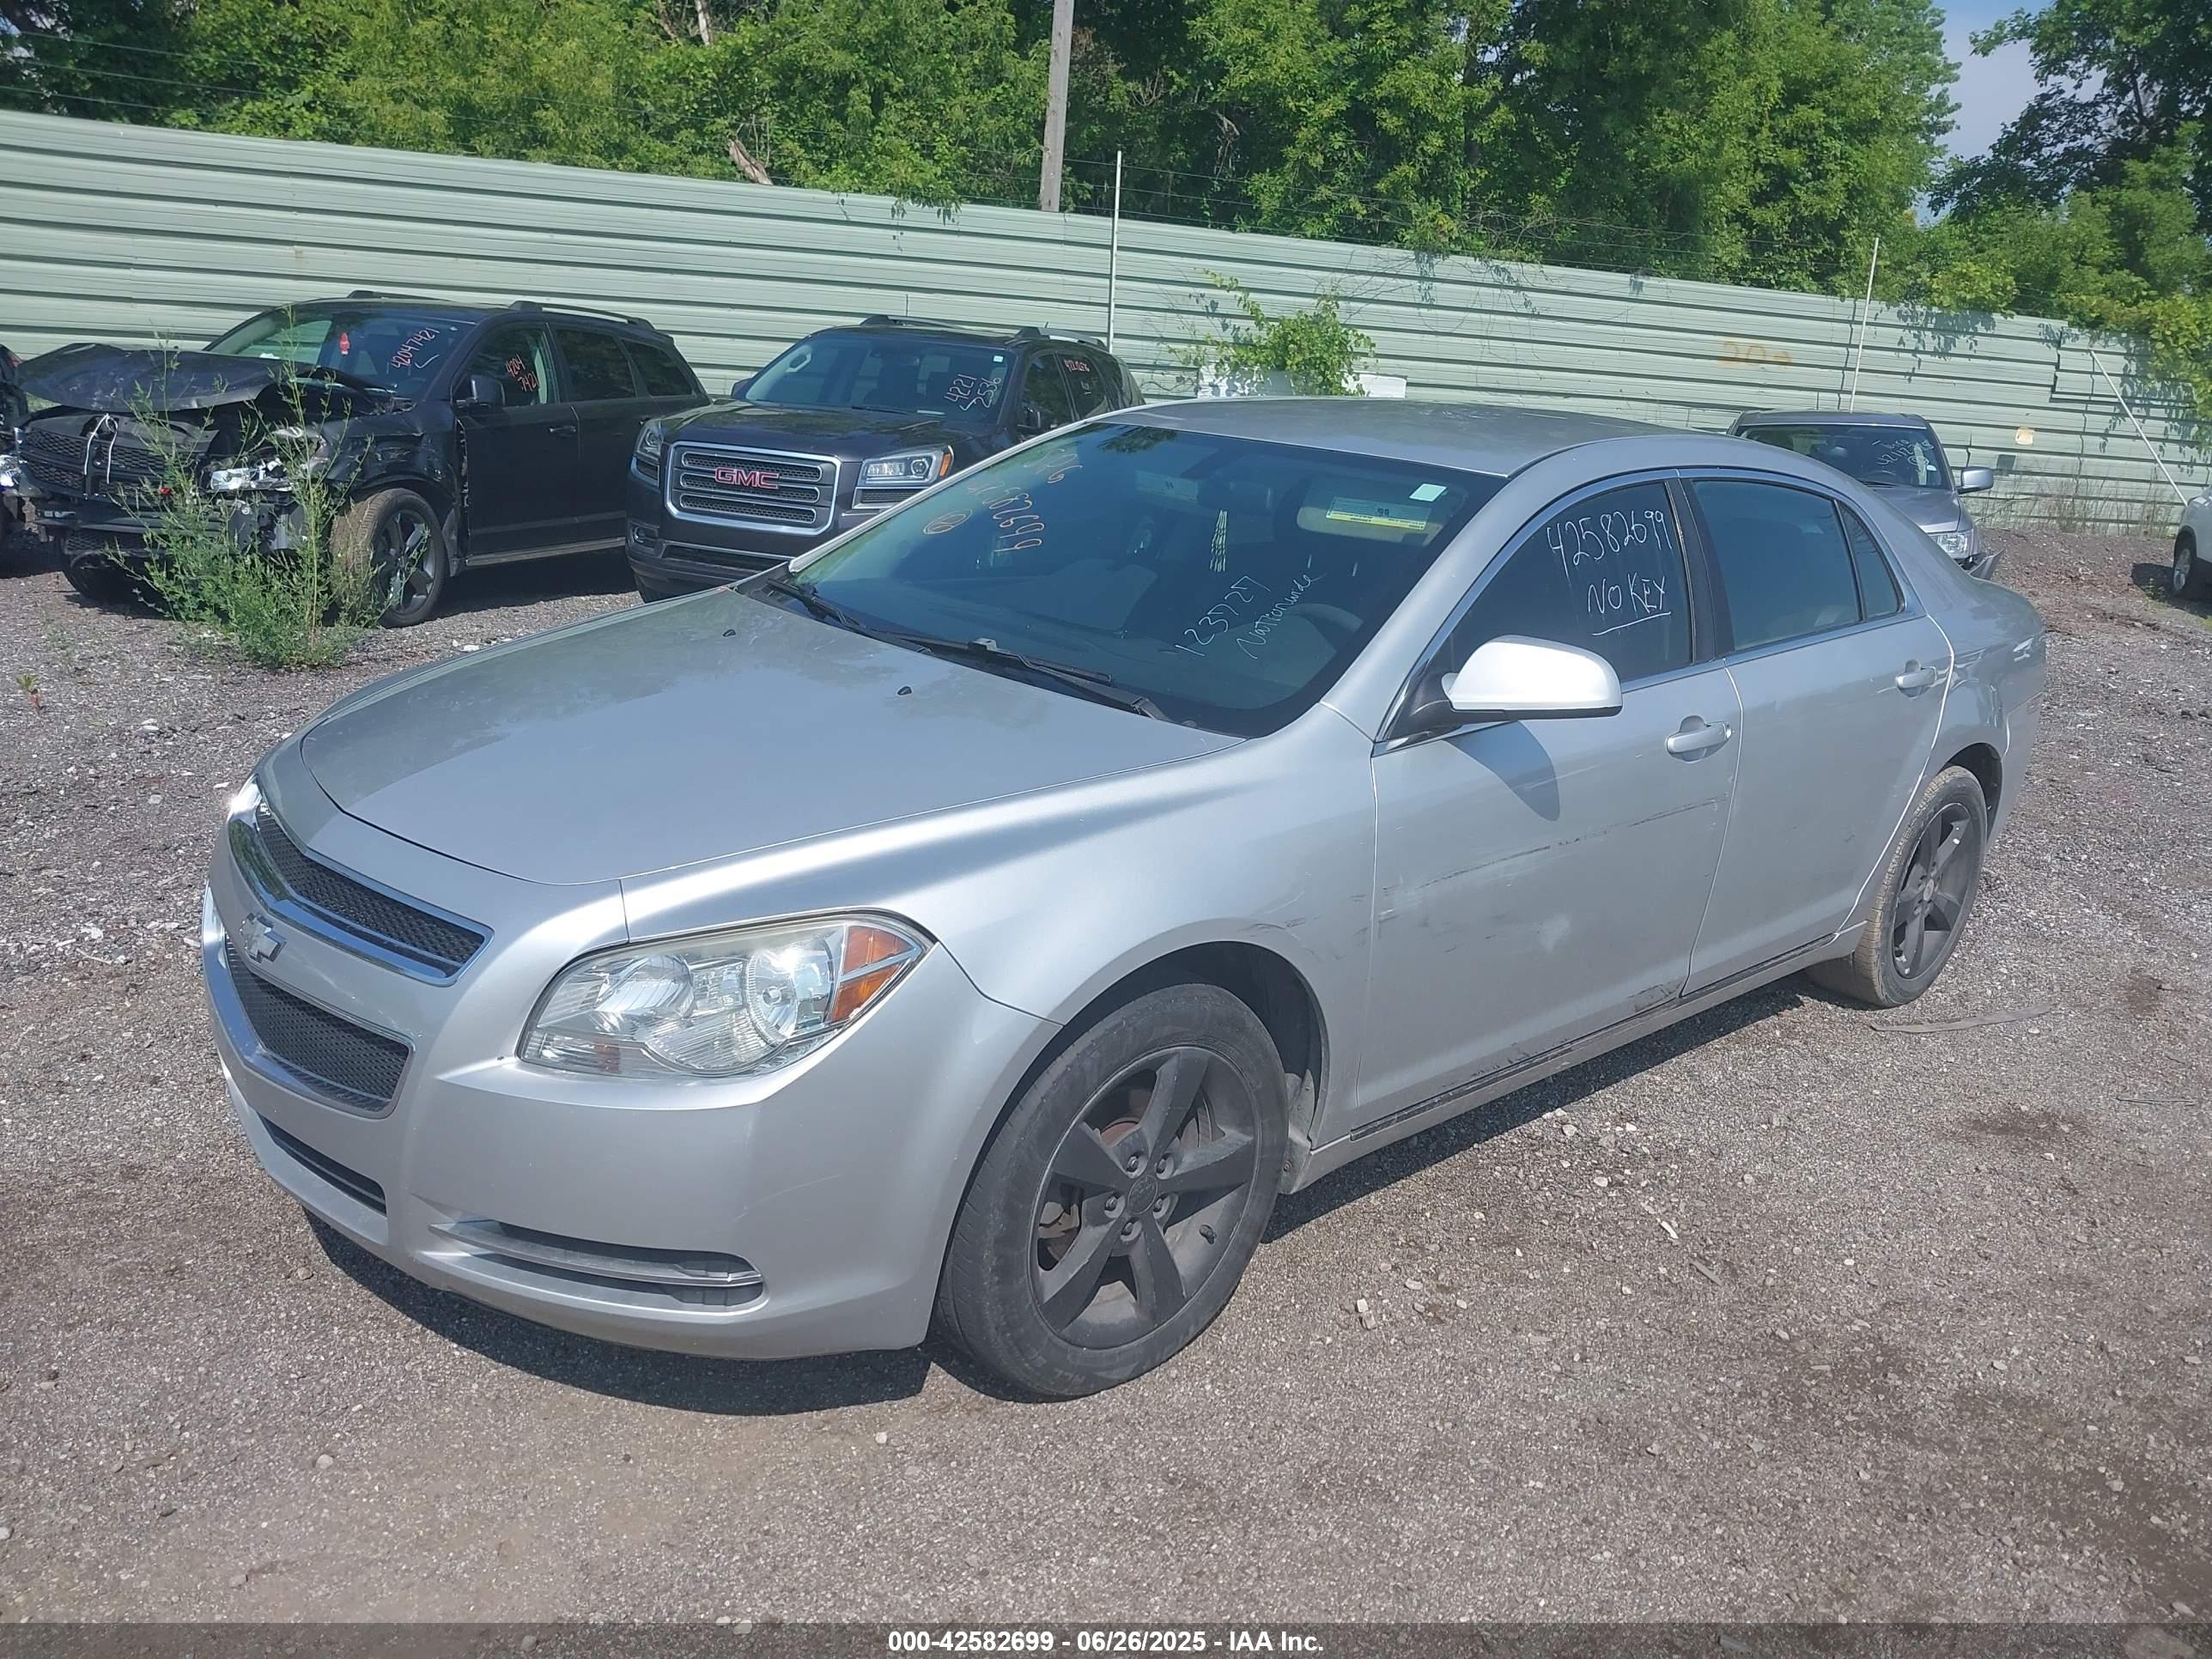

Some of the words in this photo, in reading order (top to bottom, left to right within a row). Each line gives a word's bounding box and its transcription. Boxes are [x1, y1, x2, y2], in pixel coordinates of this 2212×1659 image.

[391, 327, 440, 368] 42047421
[505, 353, 526, 377] 4204
[517, 370, 539, 392] 7421
[945, 374, 977, 402] 4221
[975, 377, 1001, 408] 2536
[714, 466, 779, 489] GMC
[1547, 510, 1673, 580] 42582699
[1588, 578, 1623, 614] NO
[1628, 572, 1666, 614] KEY
[1236, 574, 1325, 659] Nationwide
